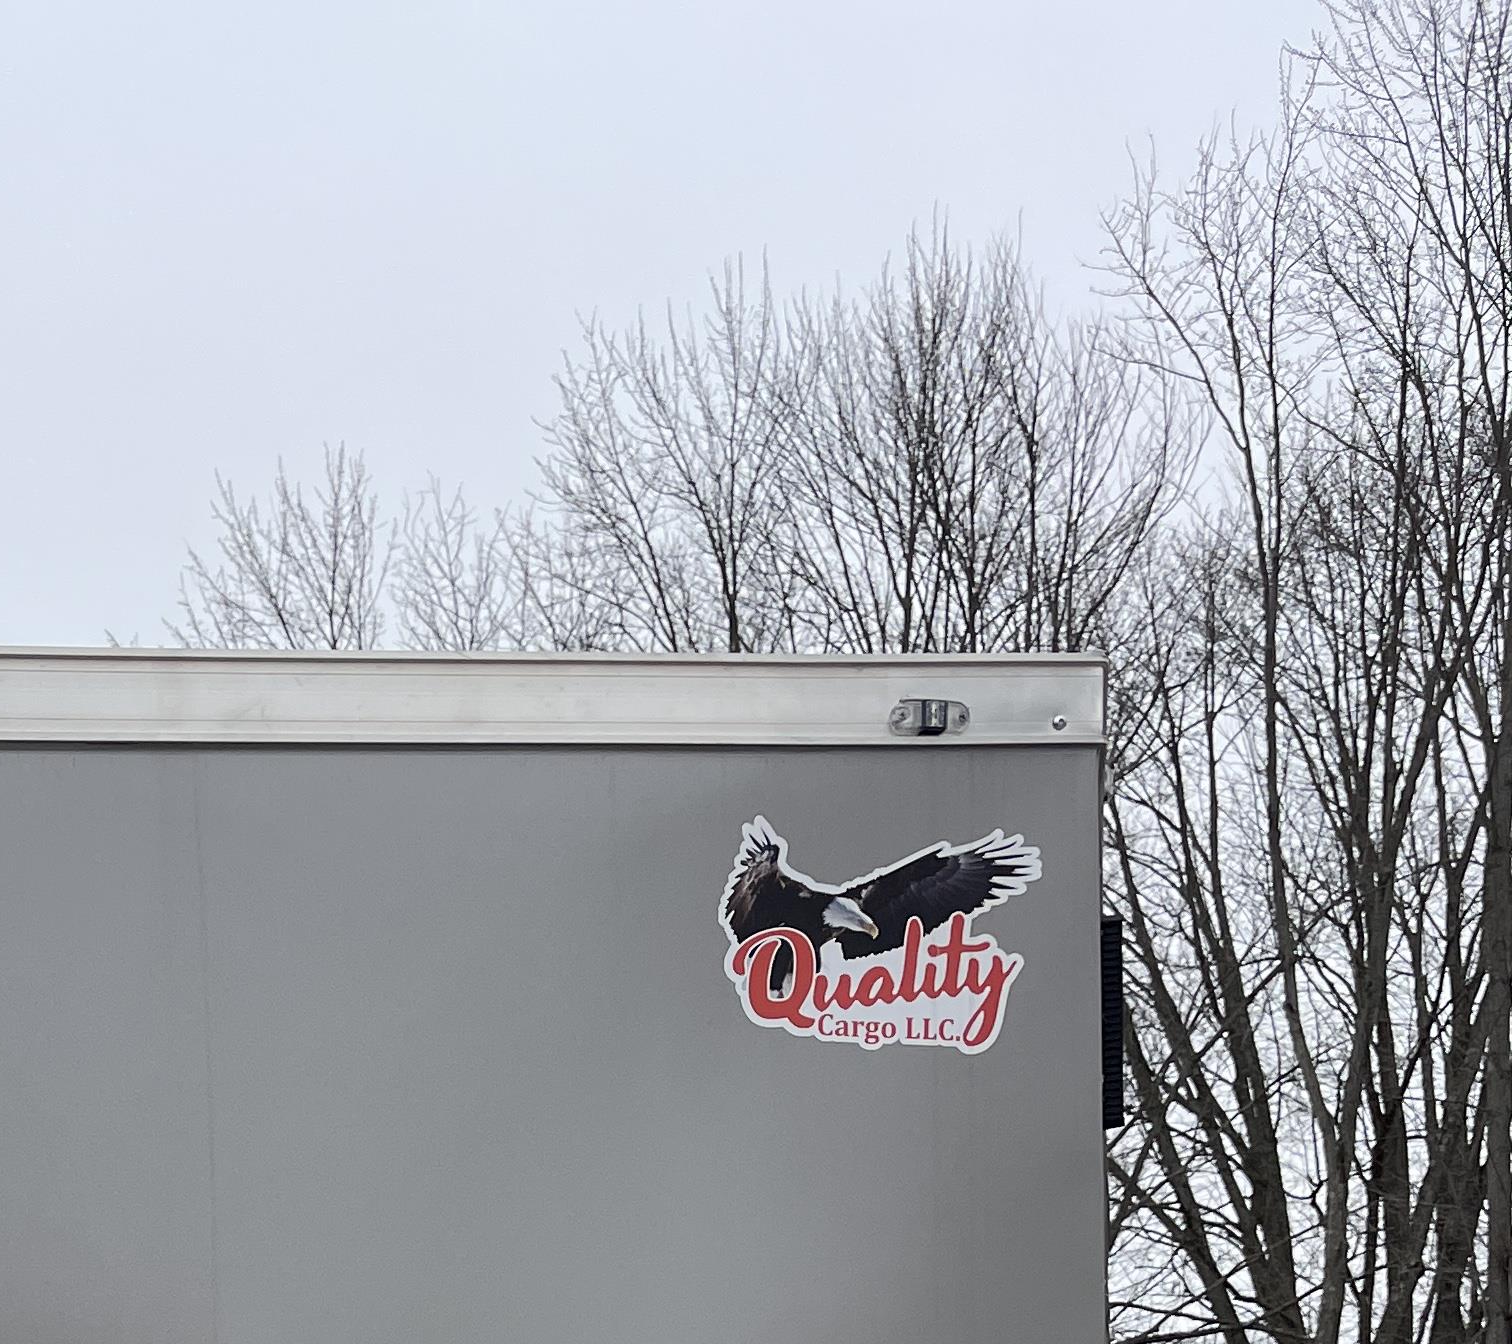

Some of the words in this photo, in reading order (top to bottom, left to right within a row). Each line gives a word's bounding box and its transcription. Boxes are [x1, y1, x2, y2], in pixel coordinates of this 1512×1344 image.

[732, 911, 1018, 1047] Quality
[817, 1013, 897, 1043] Cargo
[905, 1017, 961, 1041] LLC.
